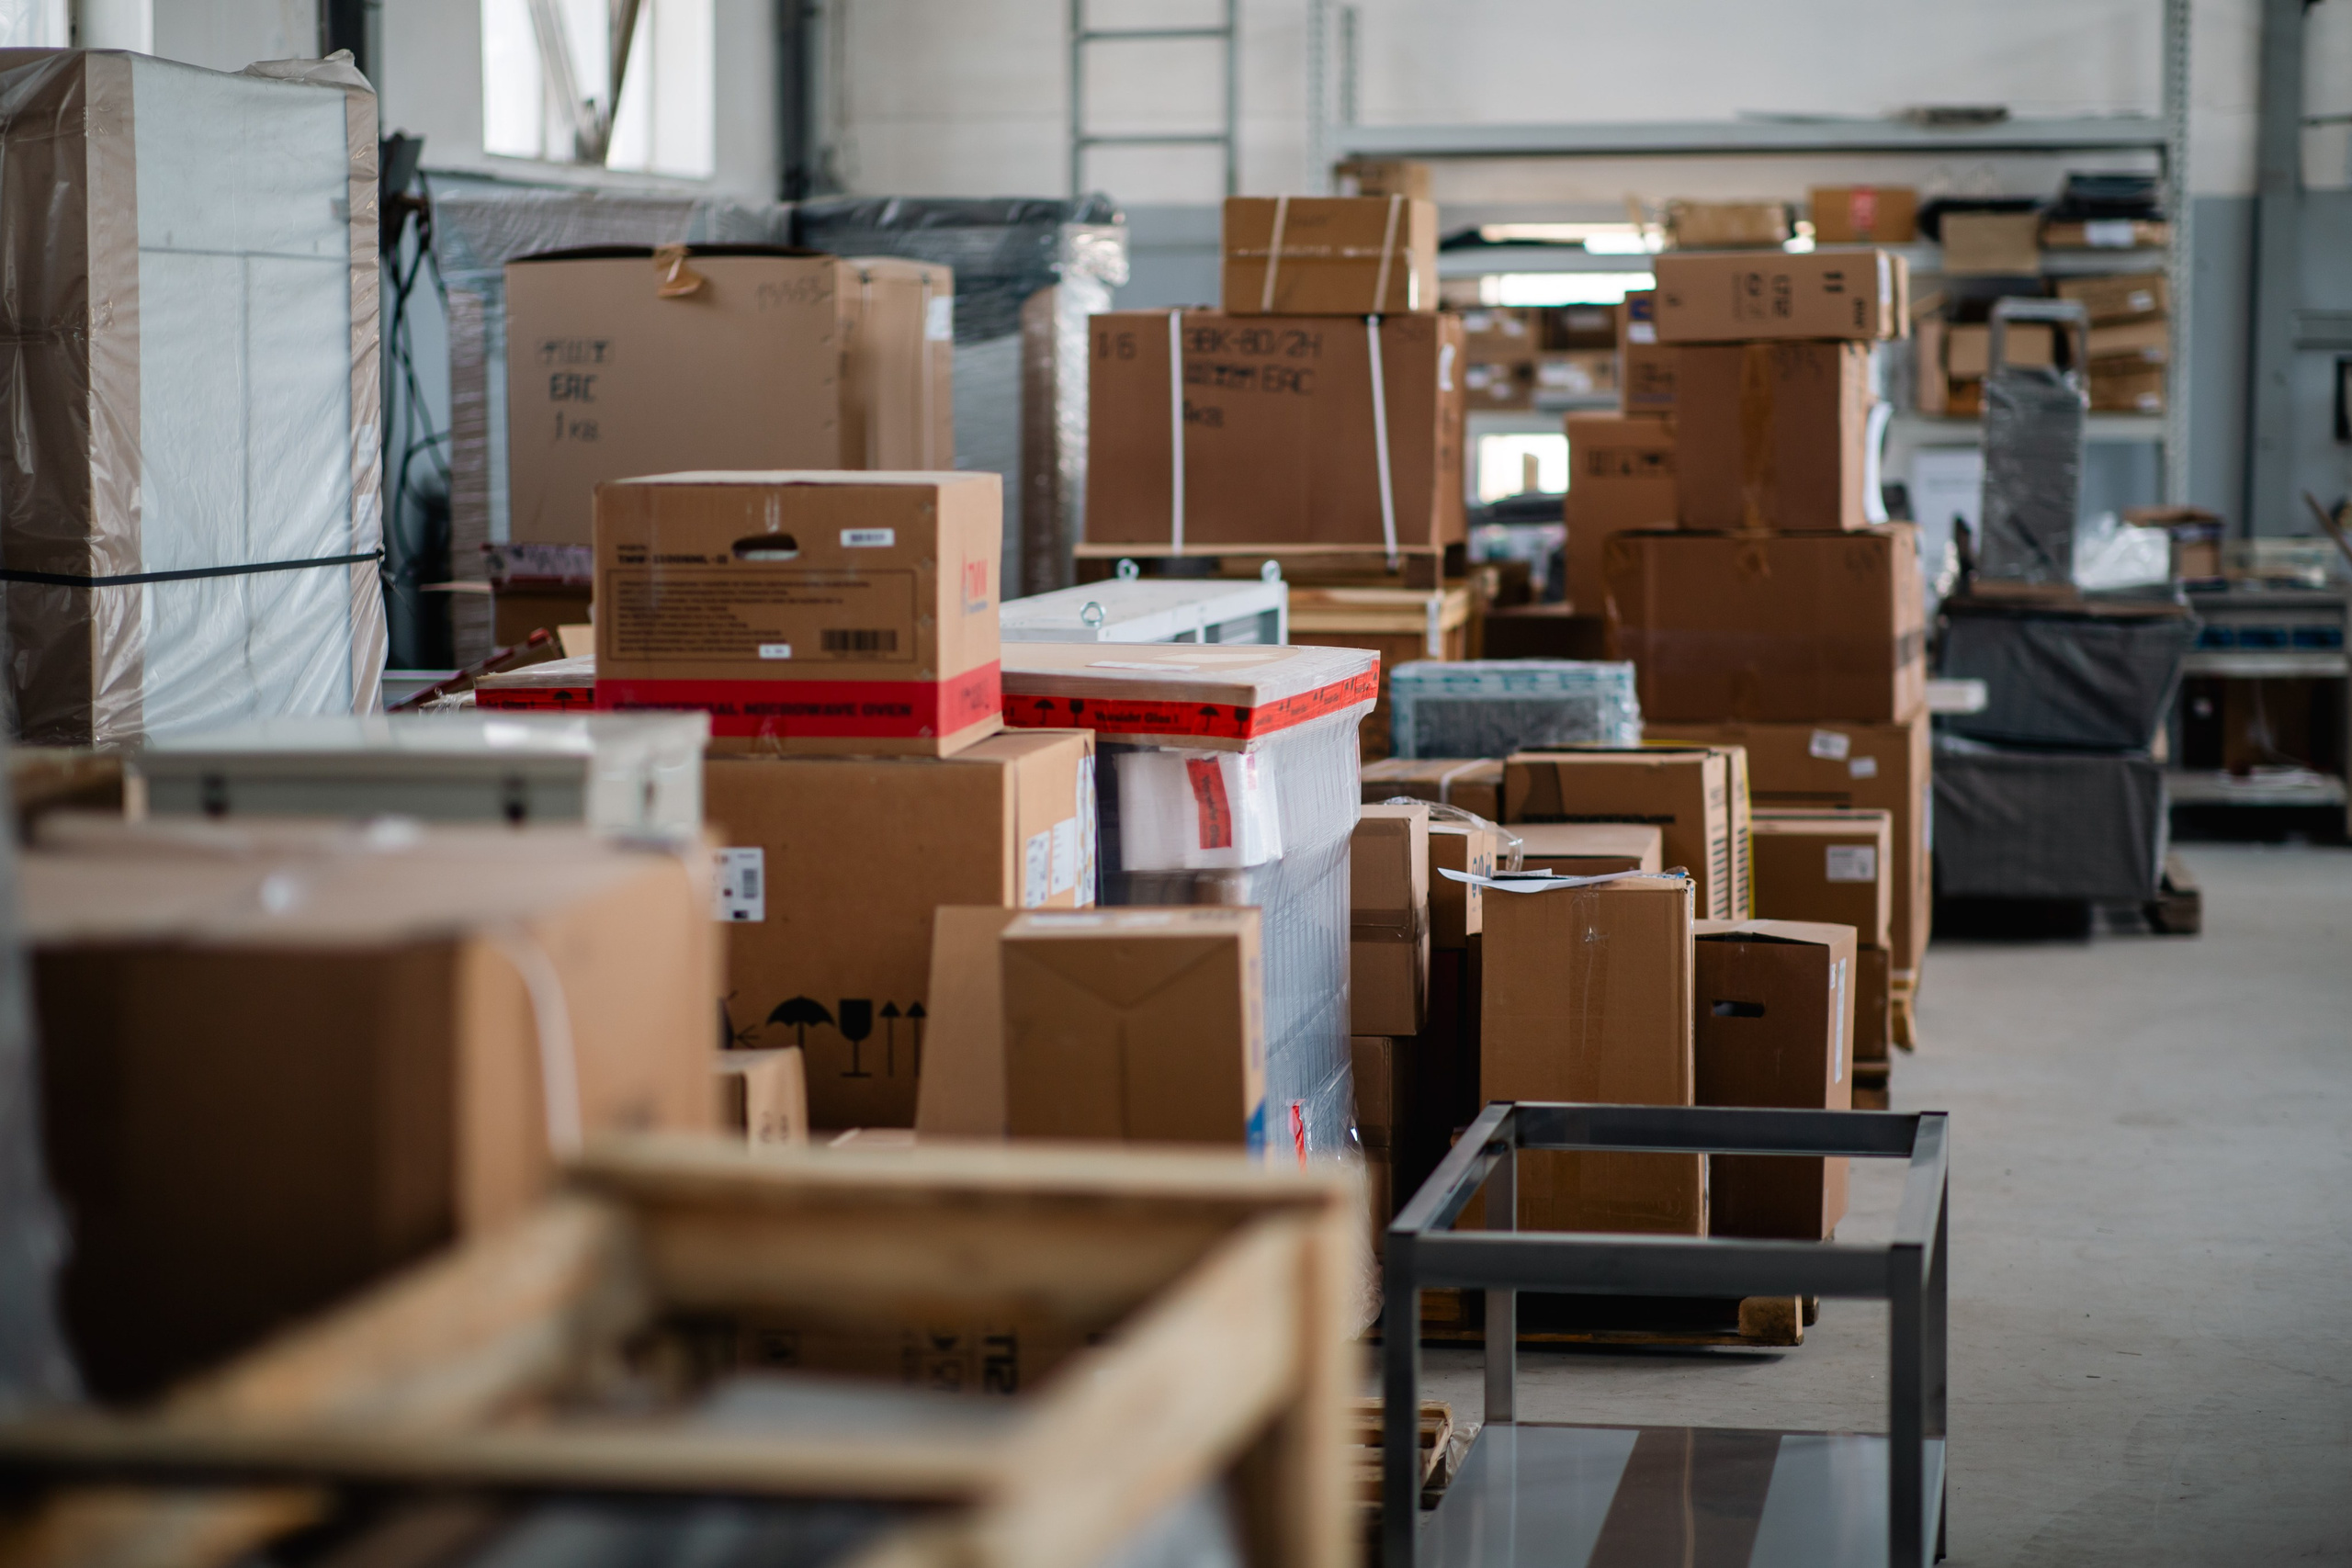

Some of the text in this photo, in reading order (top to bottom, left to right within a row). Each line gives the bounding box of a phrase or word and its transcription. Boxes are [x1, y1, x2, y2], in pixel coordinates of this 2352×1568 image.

[744, 702, 856, 716] MICROWAVE
[862, 702, 911, 716] OVEN
[1094, 710, 1141, 722] Vorsicht
[1144, 711, 1171, 724] Glas
